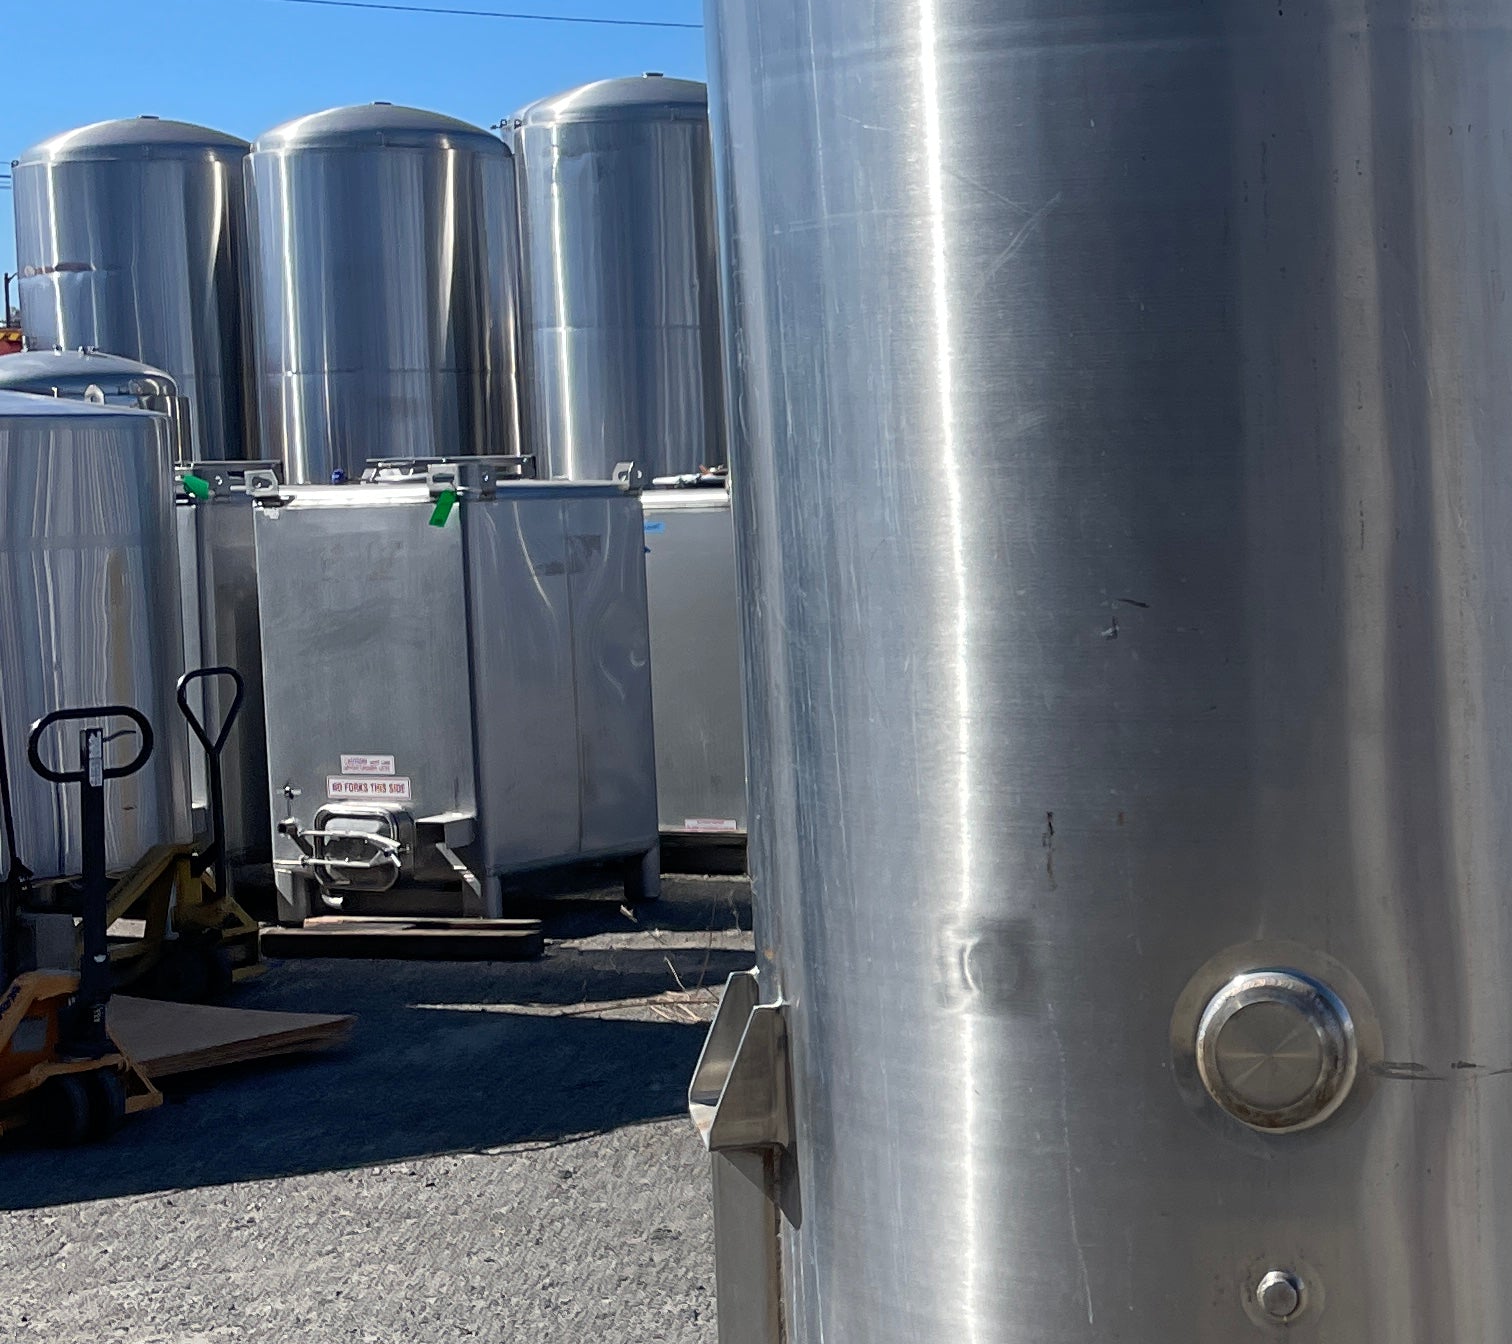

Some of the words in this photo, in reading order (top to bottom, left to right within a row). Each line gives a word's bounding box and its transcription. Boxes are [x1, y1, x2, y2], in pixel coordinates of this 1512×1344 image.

[332, 783, 342, 792] NO
[345, 783, 368, 793] FORKS
[370, 783, 386, 793] THIS
[388, 783, 404, 793] SIDE
